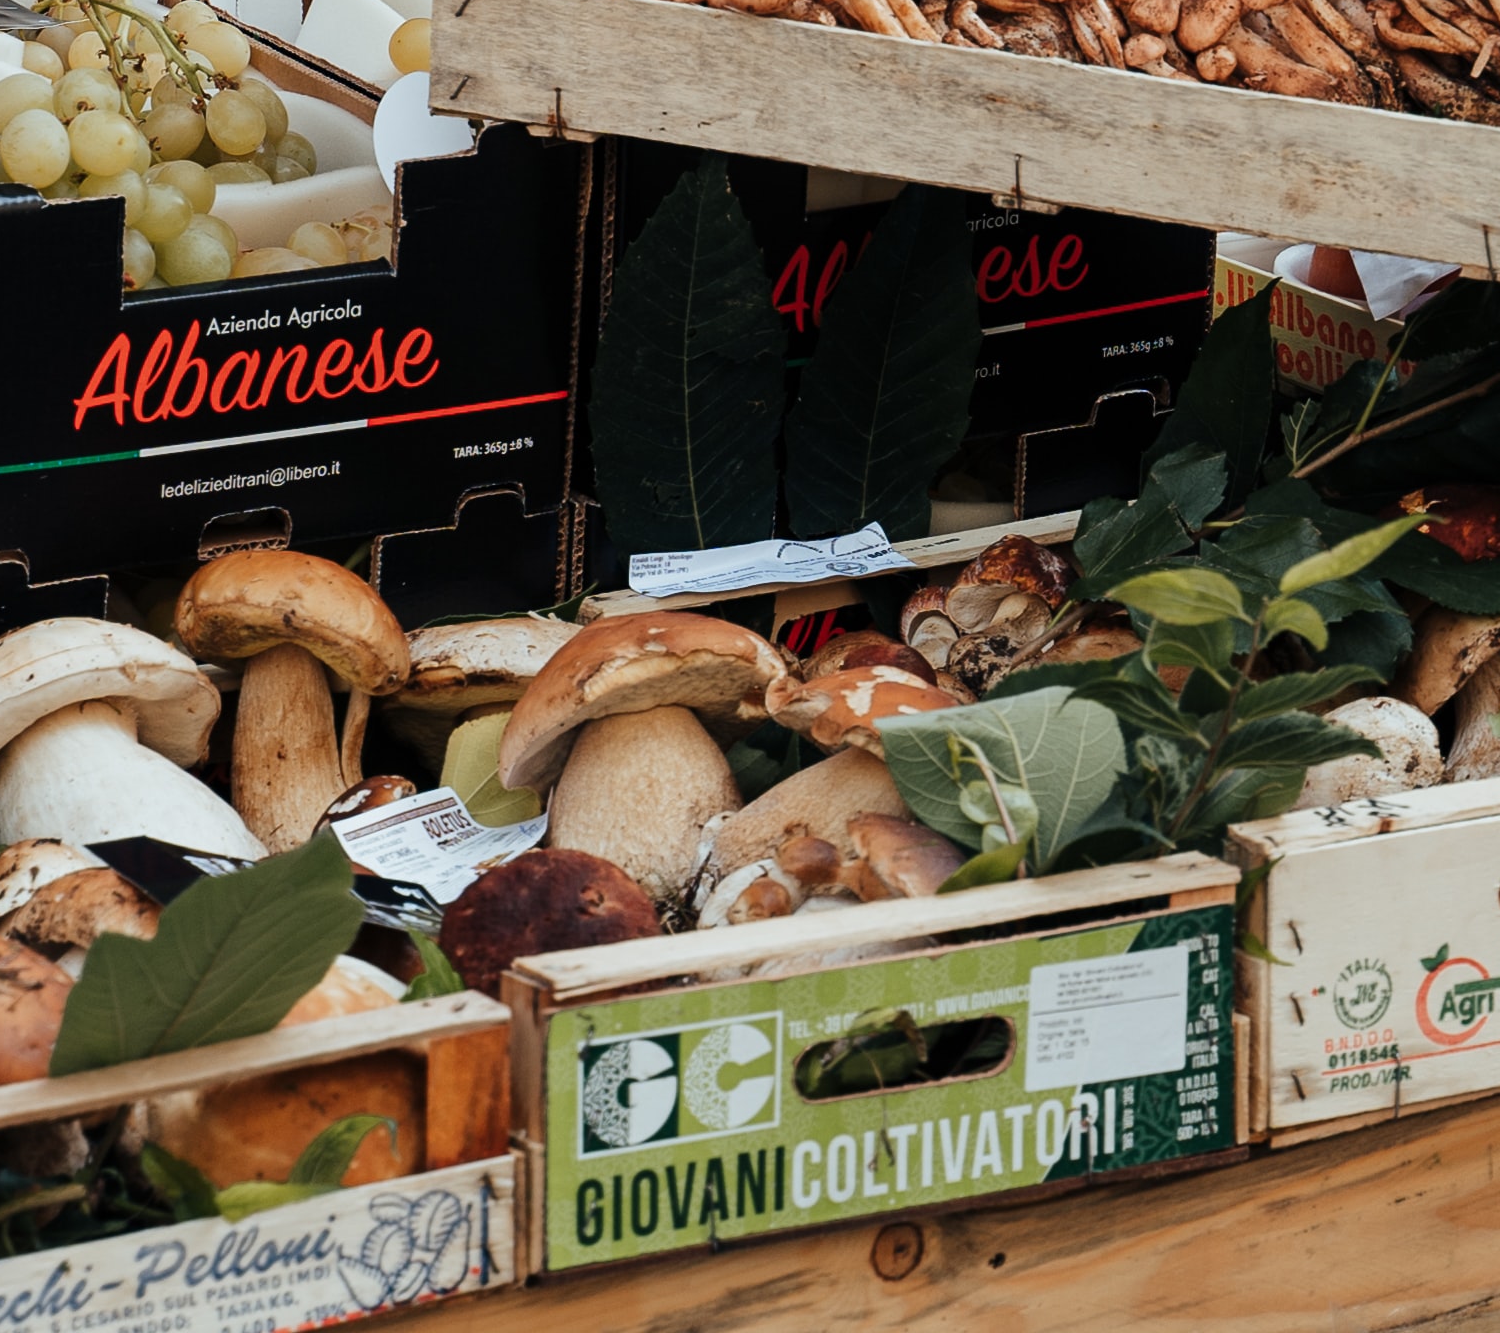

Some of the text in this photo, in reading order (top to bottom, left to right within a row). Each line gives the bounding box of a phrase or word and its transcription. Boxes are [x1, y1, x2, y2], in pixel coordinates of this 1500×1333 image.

[968, 209, 1020, 233] ricola
[771, 232, 1091, 333] Alese
[1215, 268, 1256, 309] .lli
[206, 298, 363, 337] Azienda Agricola
[73, 318, 440, 431] Albanese
[452, 435, 534, 460] TARA: 365g ±8 %
[160, 460, 341, 499] ledelizieditrani@libero.it
[422, 808, 473, 840] BOLETUS
[787, 1018, 814, 1039] TEL.
[935, 983, 1032, 1018] WWW.GIOVANICO
[1438, 989, 1495, 1026] Agri
